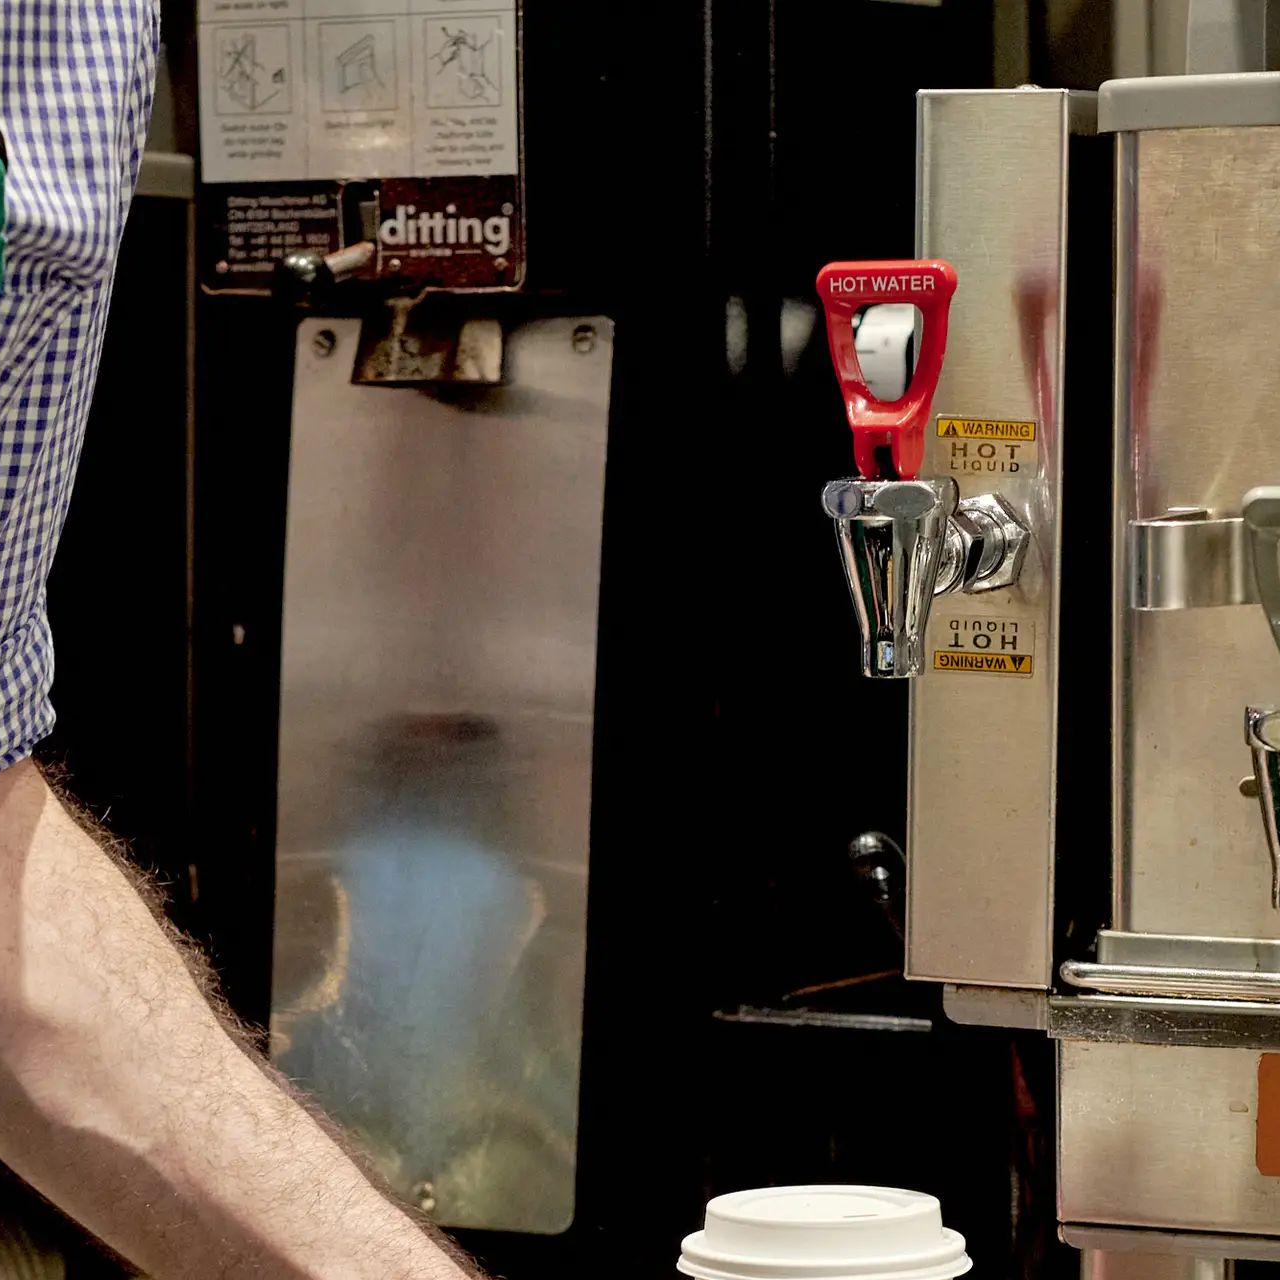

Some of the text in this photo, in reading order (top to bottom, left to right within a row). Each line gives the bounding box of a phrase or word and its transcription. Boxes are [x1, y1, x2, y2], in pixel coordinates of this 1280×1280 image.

[380, 203, 512, 256] ditting
[829, 275, 935, 293] HOT WATER
[962, 422, 1030, 437] WARNING
[951, 442, 1021, 459] HOT
[950, 459, 1020, 472] LIQUID
[949, 620, 1018, 633] LIQUID
[948, 632, 1017, 650] HOT
[939, 654, 1007, 670] WARNING
